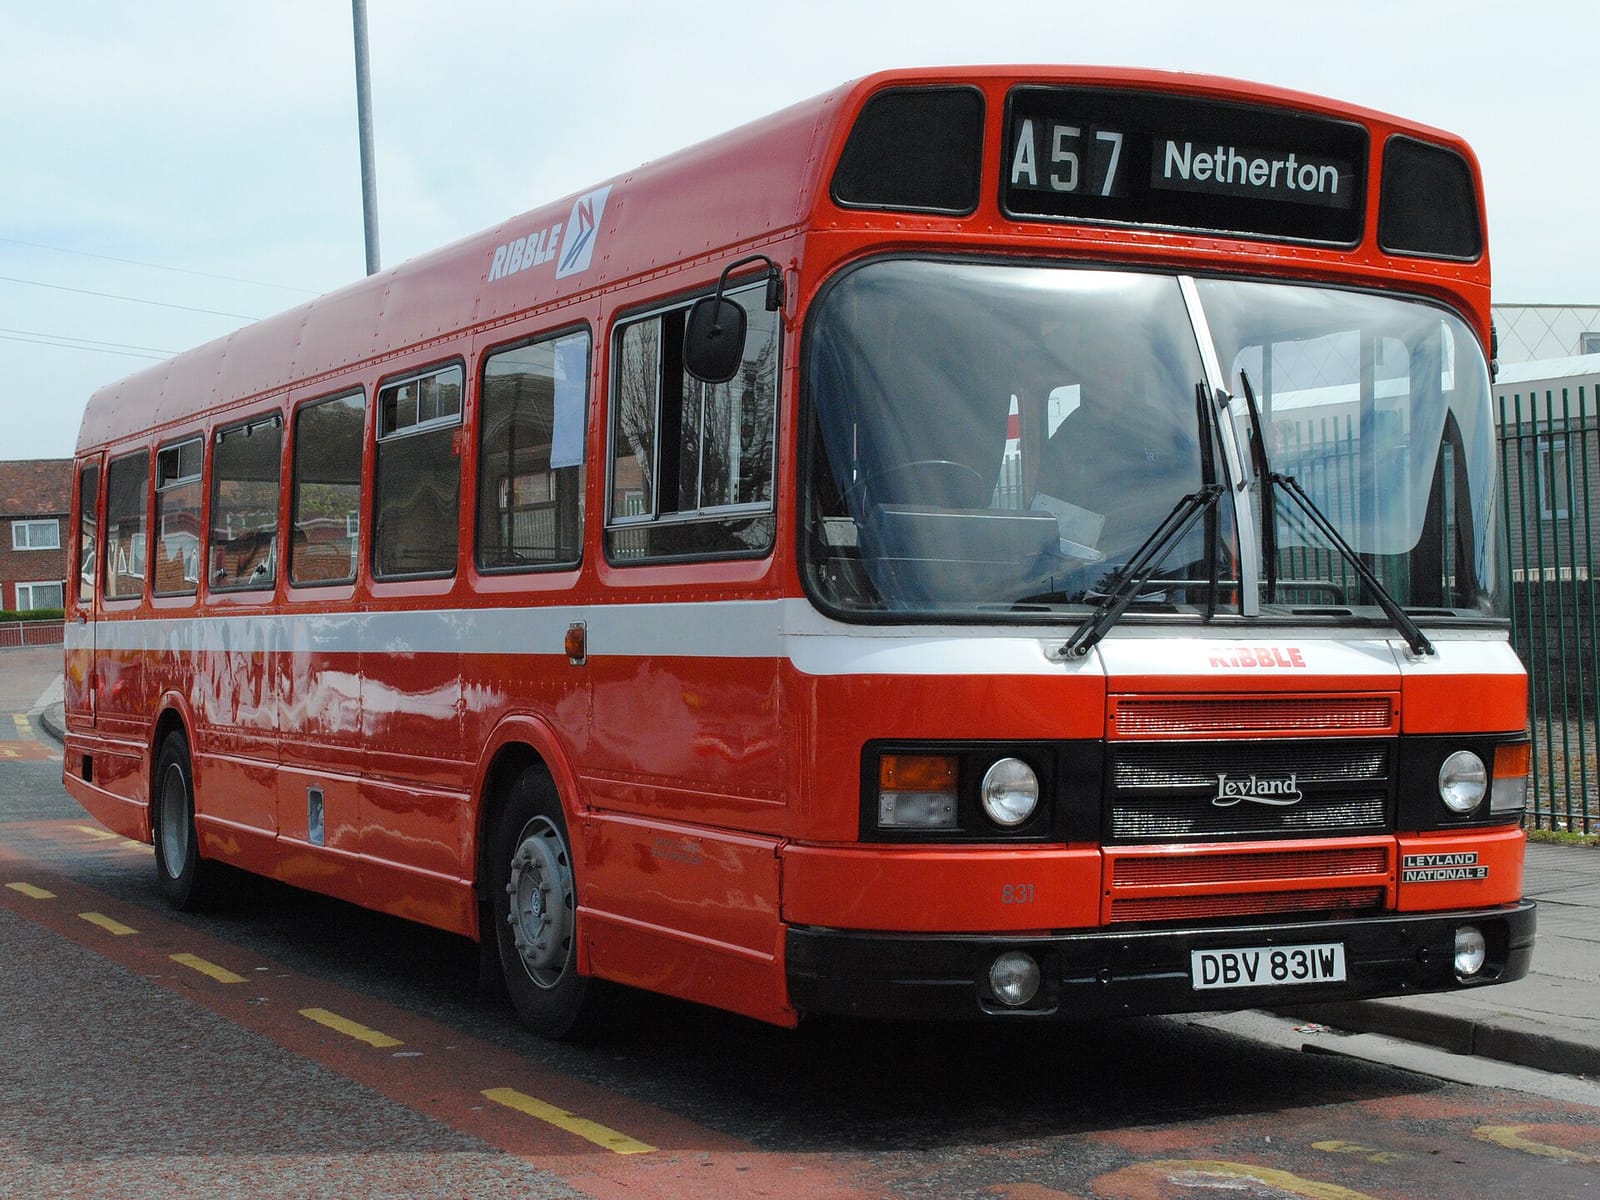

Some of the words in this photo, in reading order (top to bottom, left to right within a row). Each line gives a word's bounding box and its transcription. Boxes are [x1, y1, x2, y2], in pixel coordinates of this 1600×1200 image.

[1163, 140, 1339, 194] Netherton
[487, 222, 564, 283] RIBBLE
[1208, 647, 1307, 668] RIBBLE
[1212, 773, 1303, 807] Leyland
[1406, 868, 1473, 881] NATIONAL
[1476, 868, 1486, 877] 2
[1407, 854, 1475, 867] LEYLAND
[1001, 883, 1035, 905] 831
[1201, 951, 1260, 985] DBV
[1269, 947, 1335, 981] 831W
